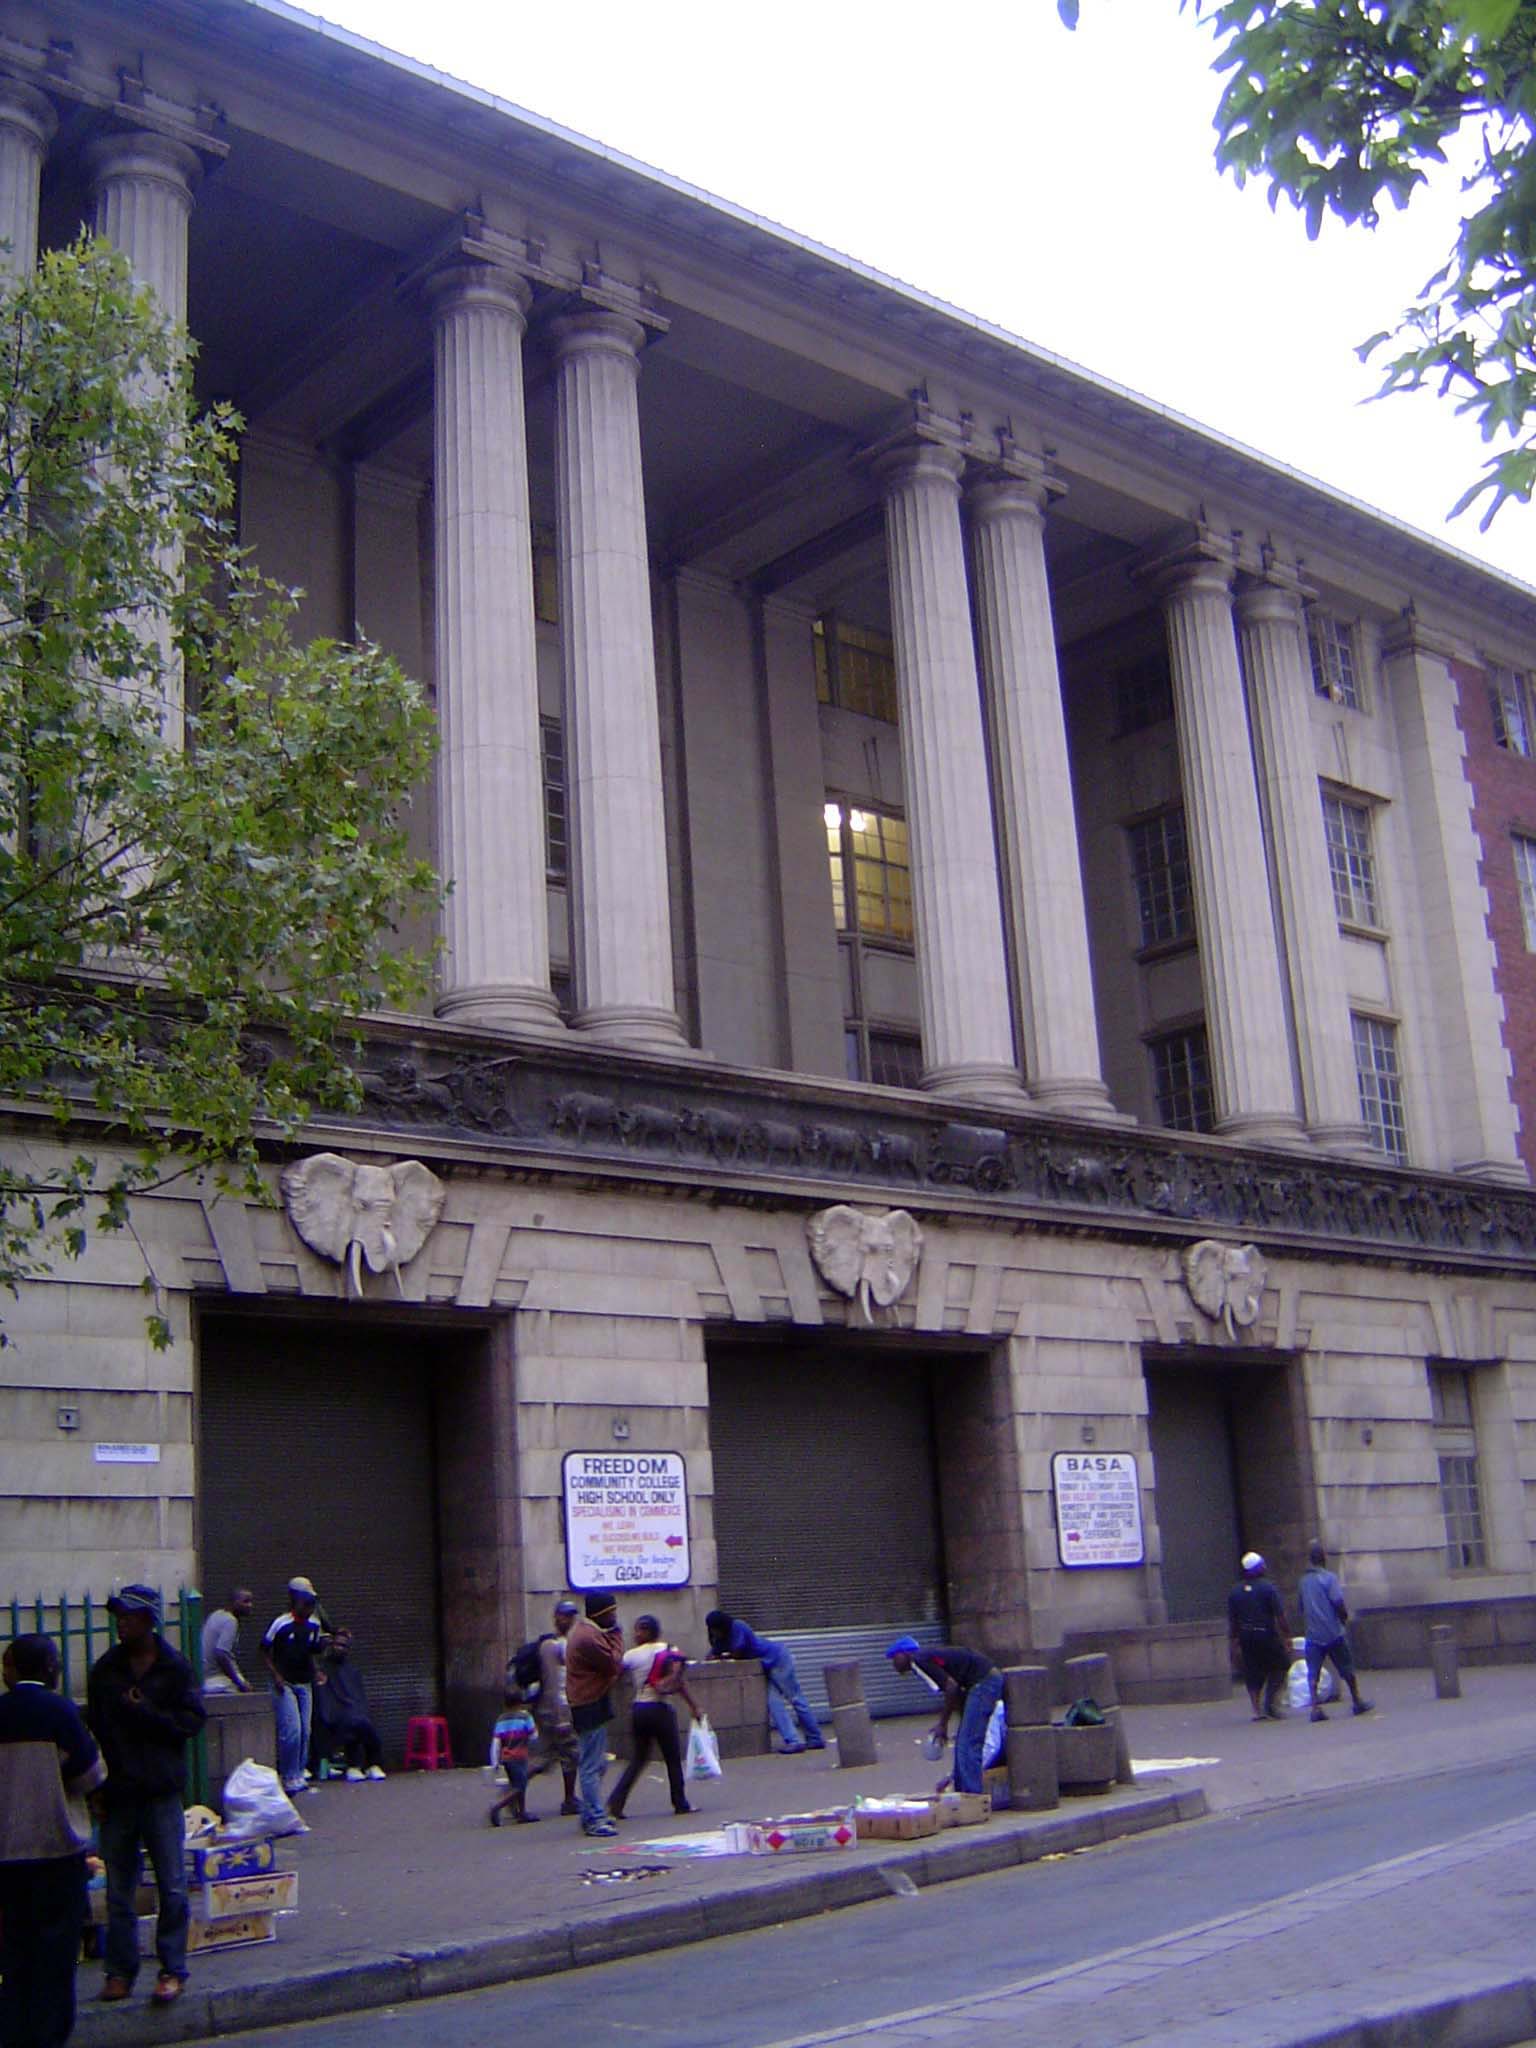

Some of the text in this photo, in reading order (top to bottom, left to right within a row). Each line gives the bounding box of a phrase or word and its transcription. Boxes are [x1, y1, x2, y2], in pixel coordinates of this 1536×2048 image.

[583, 1458, 668, 1474] FREEDOM
[1067, 1458, 1122, 1471] BASA
[570, 1476, 681, 1488] COMMUNITY COLLEGE
[577, 1491, 676, 1504] HIGH SCHOOL ONLY
[615, 1566, 643, 1581] GOD
